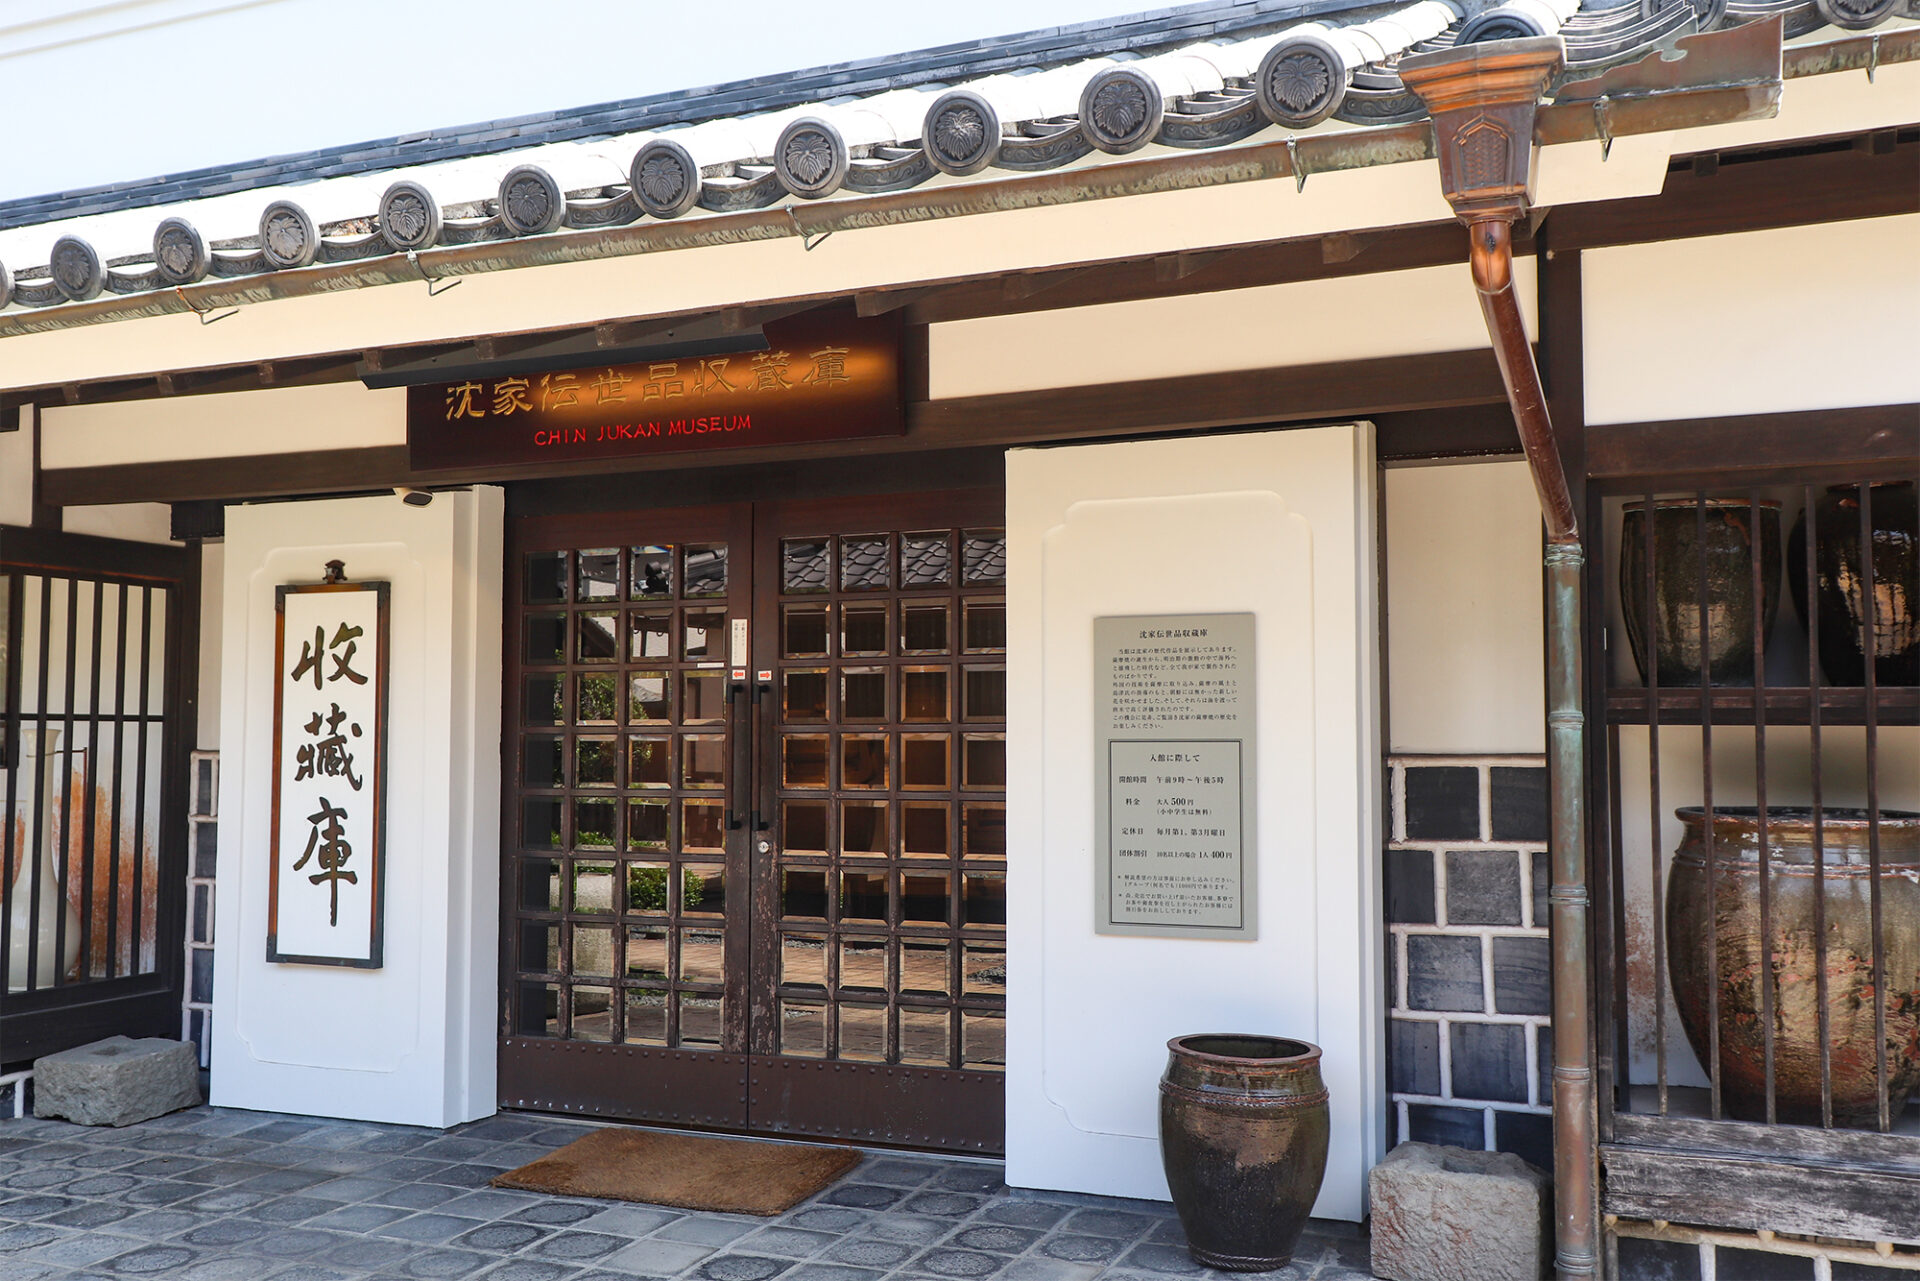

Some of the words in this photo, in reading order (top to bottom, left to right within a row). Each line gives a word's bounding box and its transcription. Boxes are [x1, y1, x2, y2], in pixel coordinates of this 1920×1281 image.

[445, 345, 850, 420] 沈家伝世品収蔵庫
[534, 429, 587, 446] CHIN
[598, 421, 660, 441] JUKAN
[669, 414, 752, 437] MUSEUM
[1139, 629, 1208, 639] 沈家伝世品収蔵庫
[1150, 754, 1200, 762] 入館に際して
[1119, 776, 1147, 784] 開館時間
[1125, 798, 1141, 806] 料金
[1119, 850, 1147, 858] 団体割引
